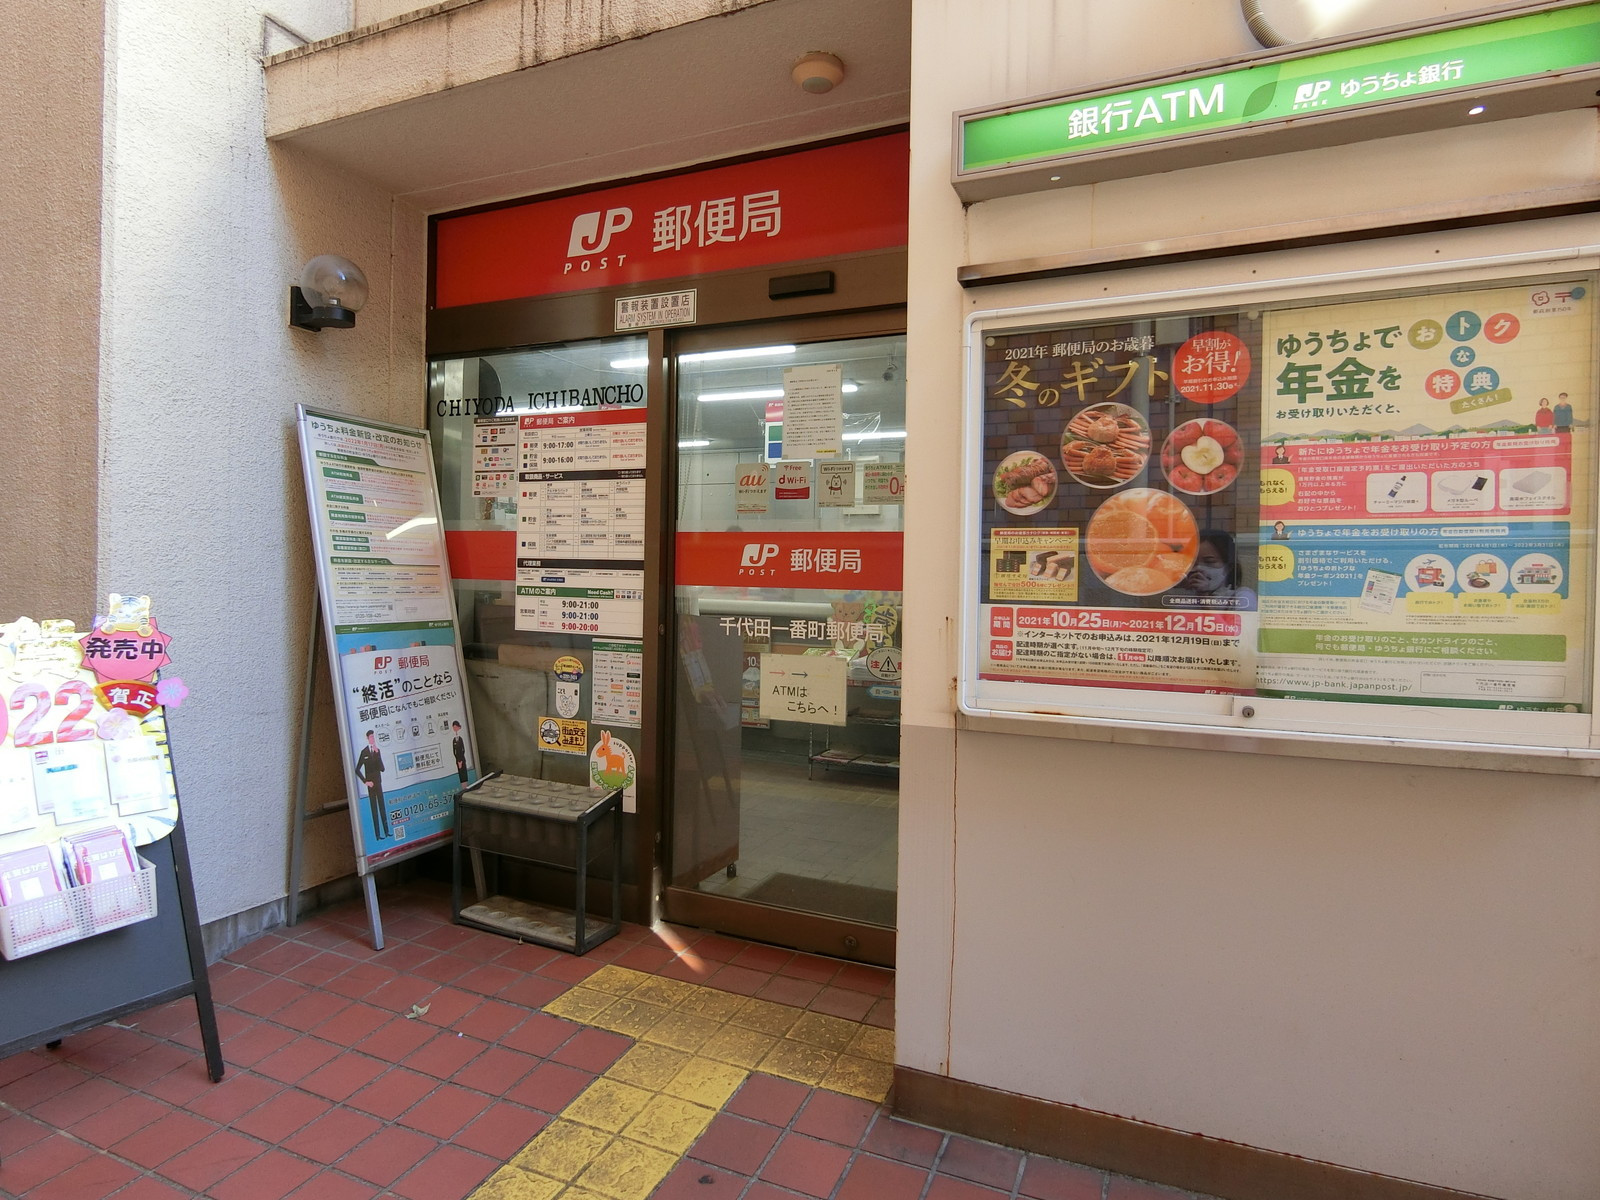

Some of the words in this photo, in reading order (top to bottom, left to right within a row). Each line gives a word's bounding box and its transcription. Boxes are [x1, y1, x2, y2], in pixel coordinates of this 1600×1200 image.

[1340, 59, 1464, 100] ゆうちょ銀行
[1067, 83, 1226, 140] 銀行ATM
[653, 189, 782, 254] 郵便局
[563, 254, 627, 275] POST
[621, 294, 690, 314] 警報装置設置店
[636, 311, 657, 322] SYSTEM
[664, 307, 691, 320] OPERATION
[1005, 344, 1049, 361] 2021年
[1052, 336, 1155, 358] 郵便局のお歳暮
[1192, 338, 1232, 352] 早割が
[1277, 325, 1402, 359] ゆうちょで
[994, 355, 1169, 408] 冬のギフト
[1276, 356, 1402, 404] 年金を
[1432, 372, 1493, 394] 特典
[437, 396, 515, 417] CHIYODA
[528, 384, 644, 410] ICHIBANCHO
[1275, 404, 1401, 420] お受け取りいただくと、
[557, 416, 575, 426] ご案内
[311, 421, 422, 450] ゆうちょ料金新設・改定のお知らせ
[543, 441, 574, 450] 9:00-17:00
[1298, 440, 1491, 457] 新たにゆうちょで年金をお受け取り予定の方
[542, 456, 574, 465] 9:00-16:00
[740, 474, 767, 487] au
[787, 476, 807, 484] Wi-Fi
[1297, 489, 1336, 497] 右記の中から
[1297, 527, 1440, 537] ゆうちょで年金をお受け取りの方
[994, 537, 1074, 545] 早期お申込みキャンペーン
[790, 548, 862, 574] 郵便局
[1297, 549, 1367, 557] さまざまなサービスを
[738, 568, 776, 577] POST
[520, 588, 556, 597] ATMのご案内
[562, 600, 599, 610] 9:00-21:00
[562, 611, 599, 621] 9:00-21:00
[562, 622, 599, 632] 9:00-20:00
[719, 616, 884, 643] 千代田一番町郵便局
[993, 620, 1011, 629] 期間
[1315, 634, 1498, 647] 年金のお受け取りのこと、セカンドライフのこと、
[85, 637, 164, 661] 発売中
[991, 649, 1013, 658] お届け
[1314, 643, 1498, 656] 何でも郵便局・ゆうちょ銀行にご相談ください。
[398, 655, 430, 671] 郵便局
[108, 687, 156, 709] 賀正
[772, 684, 808, 698] ATMは
[0, 680, 95, 748] 22
[359, 691, 457, 722] 郵便局になんでもご相談ください
[613, 741, 634, 764] supporter
[404, 794, 456, 816] 0120-65-37
